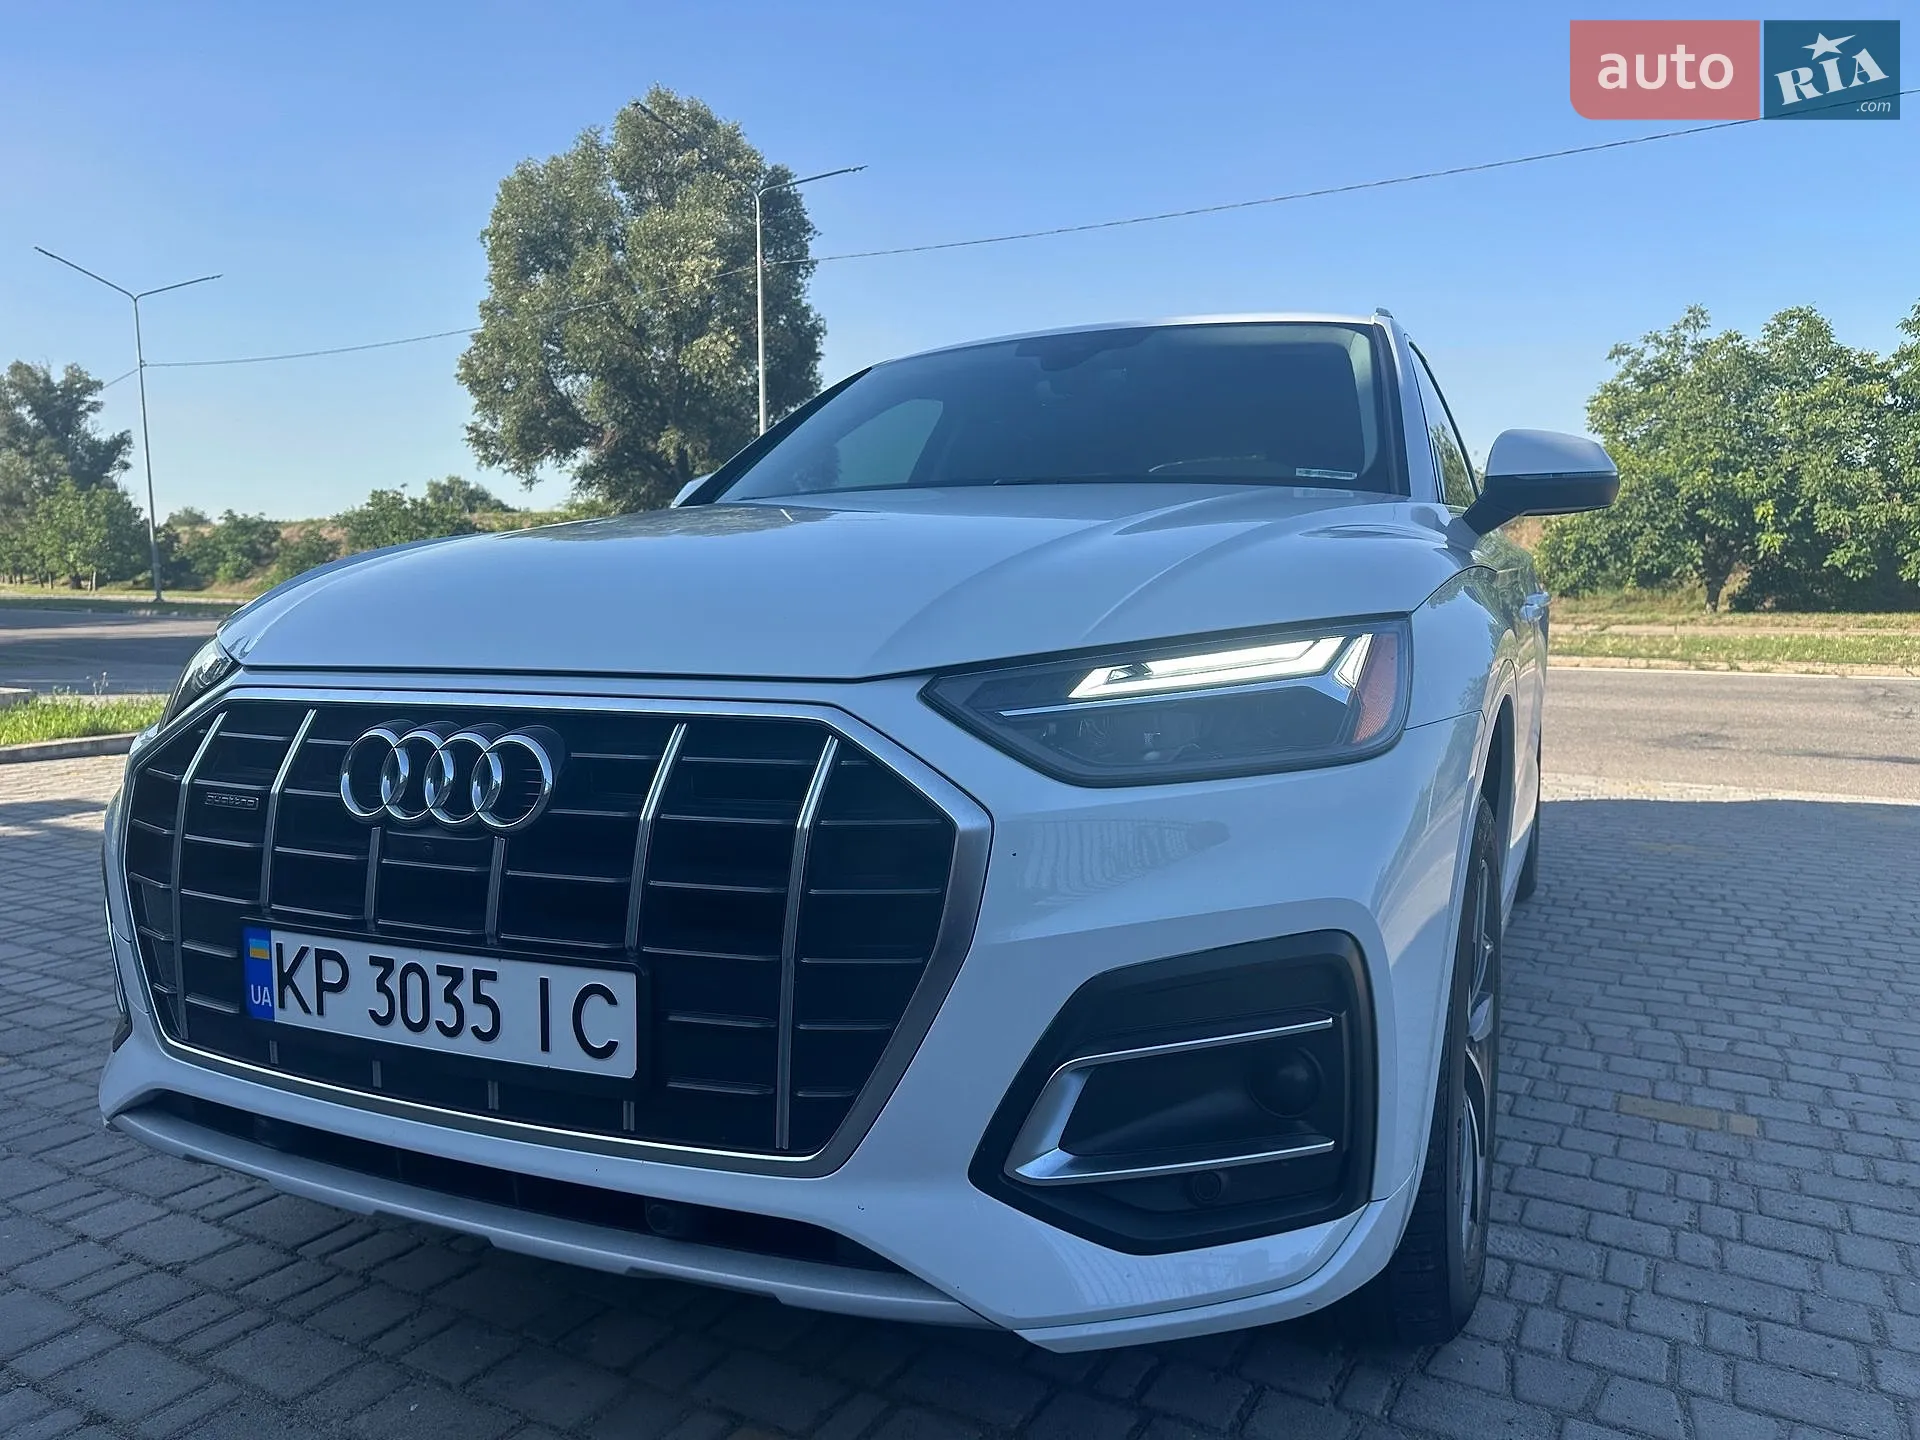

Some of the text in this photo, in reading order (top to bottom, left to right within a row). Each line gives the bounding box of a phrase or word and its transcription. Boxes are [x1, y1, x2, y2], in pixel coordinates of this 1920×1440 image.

[250, 983, 272, 1008] UA
[275, 942, 350, 1017] KP
[368, 955, 501, 1042] 3035
